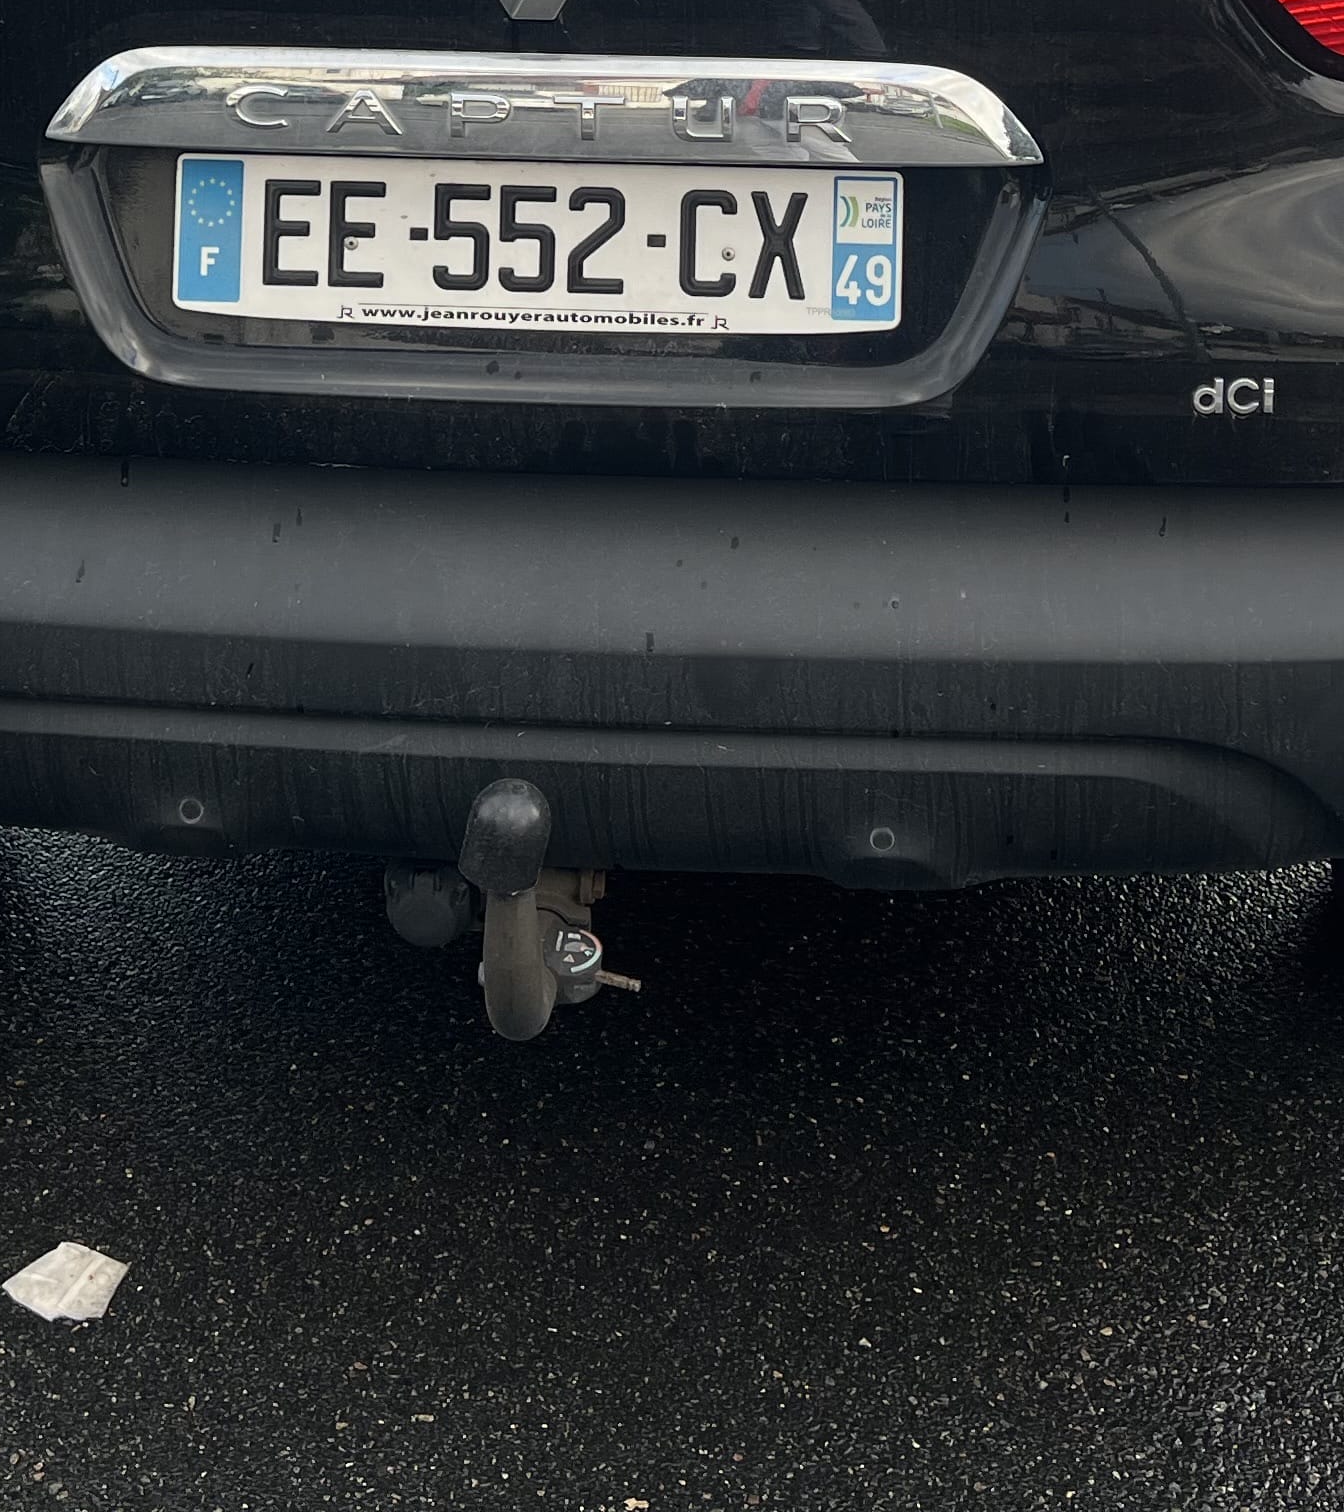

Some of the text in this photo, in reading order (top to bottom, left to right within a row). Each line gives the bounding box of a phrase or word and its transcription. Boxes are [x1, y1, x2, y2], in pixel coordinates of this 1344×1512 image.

[224, 85, 853, 144] CAPTUR
[861, 218, 892, 229] LOIRE
[865, 202, 892, 213] PAYS
[262, 178, 809, 301] EE-552-CX
[200, 247, 219, 276] F
[835, 254, 893, 307] 49
[360, 306, 706, 329] www.jeanrouyerautomobiles.fr
[1193, 377, 1275, 415] dCi
